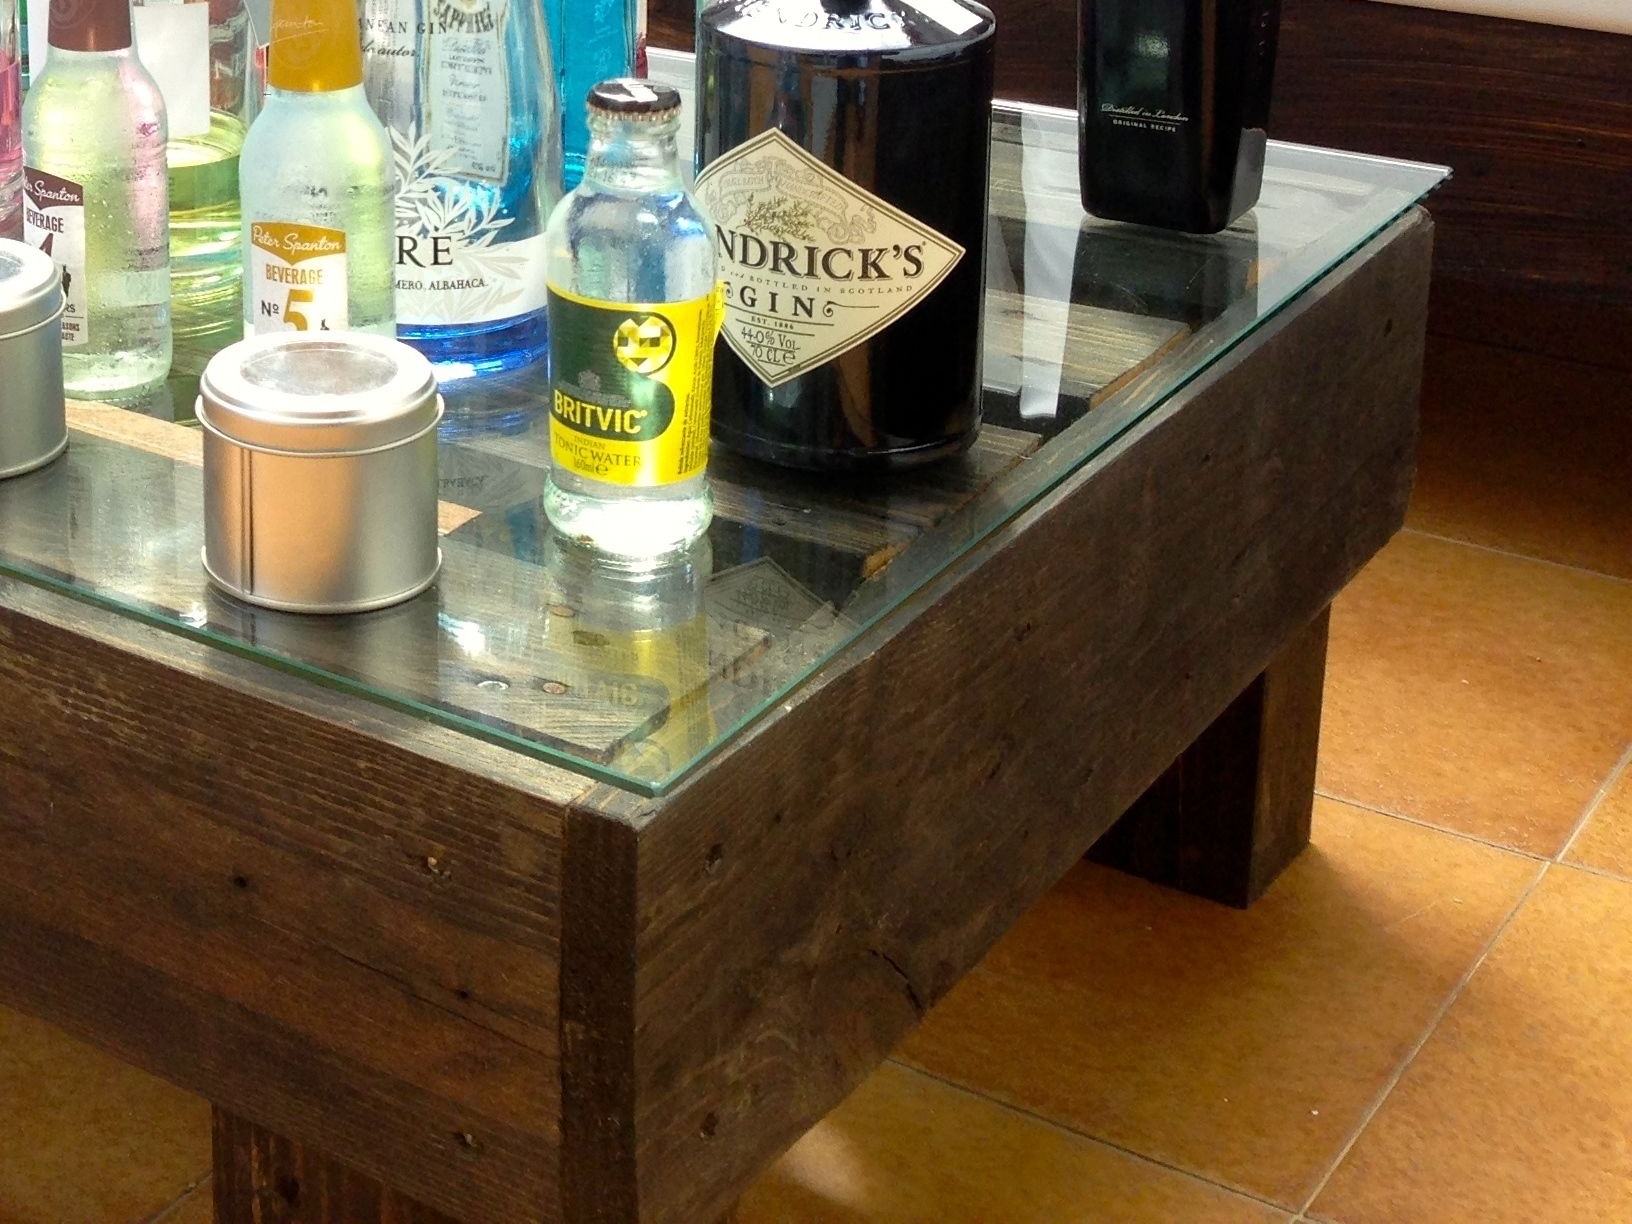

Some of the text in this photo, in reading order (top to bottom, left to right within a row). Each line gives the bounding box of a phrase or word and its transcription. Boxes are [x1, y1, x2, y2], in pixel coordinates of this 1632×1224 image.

[416, 22, 447, 35] GIN
[1112, 119, 1148, 129] ORIGINAL
[35, 179, 80, 202] Spanton
[26, 207, 64, 234] BEVERAGE
[252, 224, 342, 255] Peter Spanton
[265, 263, 323, 285] BEVERAGE
[749, 275, 809, 292] BOTTLED
[840, 284, 914, 295] SCOTLAND
[739, 285, 816, 319] GIN
[554, 388, 648, 434] BRITVIC
[554, 431, 641, 468] TONIC WATER
[574, 435, 607, 450] INDIAN
